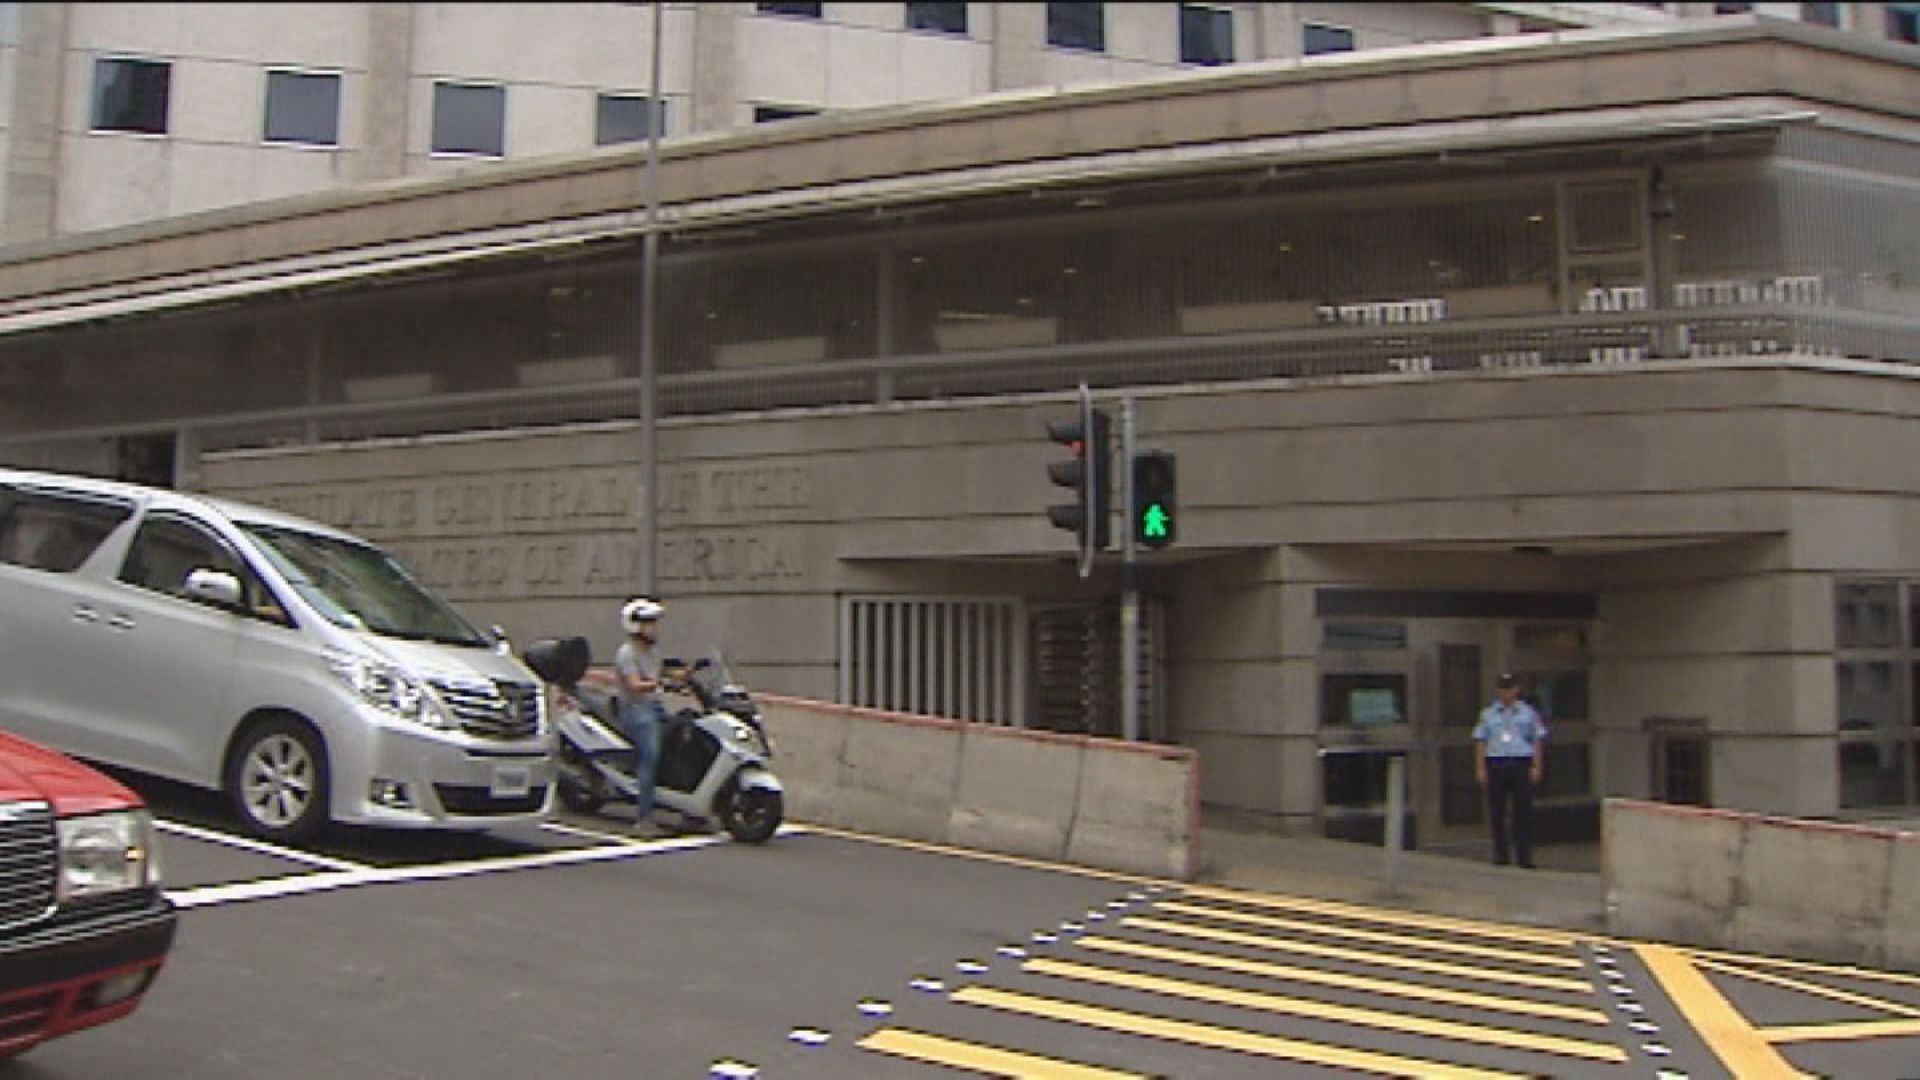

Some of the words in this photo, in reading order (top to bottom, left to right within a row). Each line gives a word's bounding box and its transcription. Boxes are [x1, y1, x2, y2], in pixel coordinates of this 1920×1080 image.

[433, 476, 629, 524] GENERAL
[704, 465, 810, 513] THE
[523, 543, 571, 587] OF
